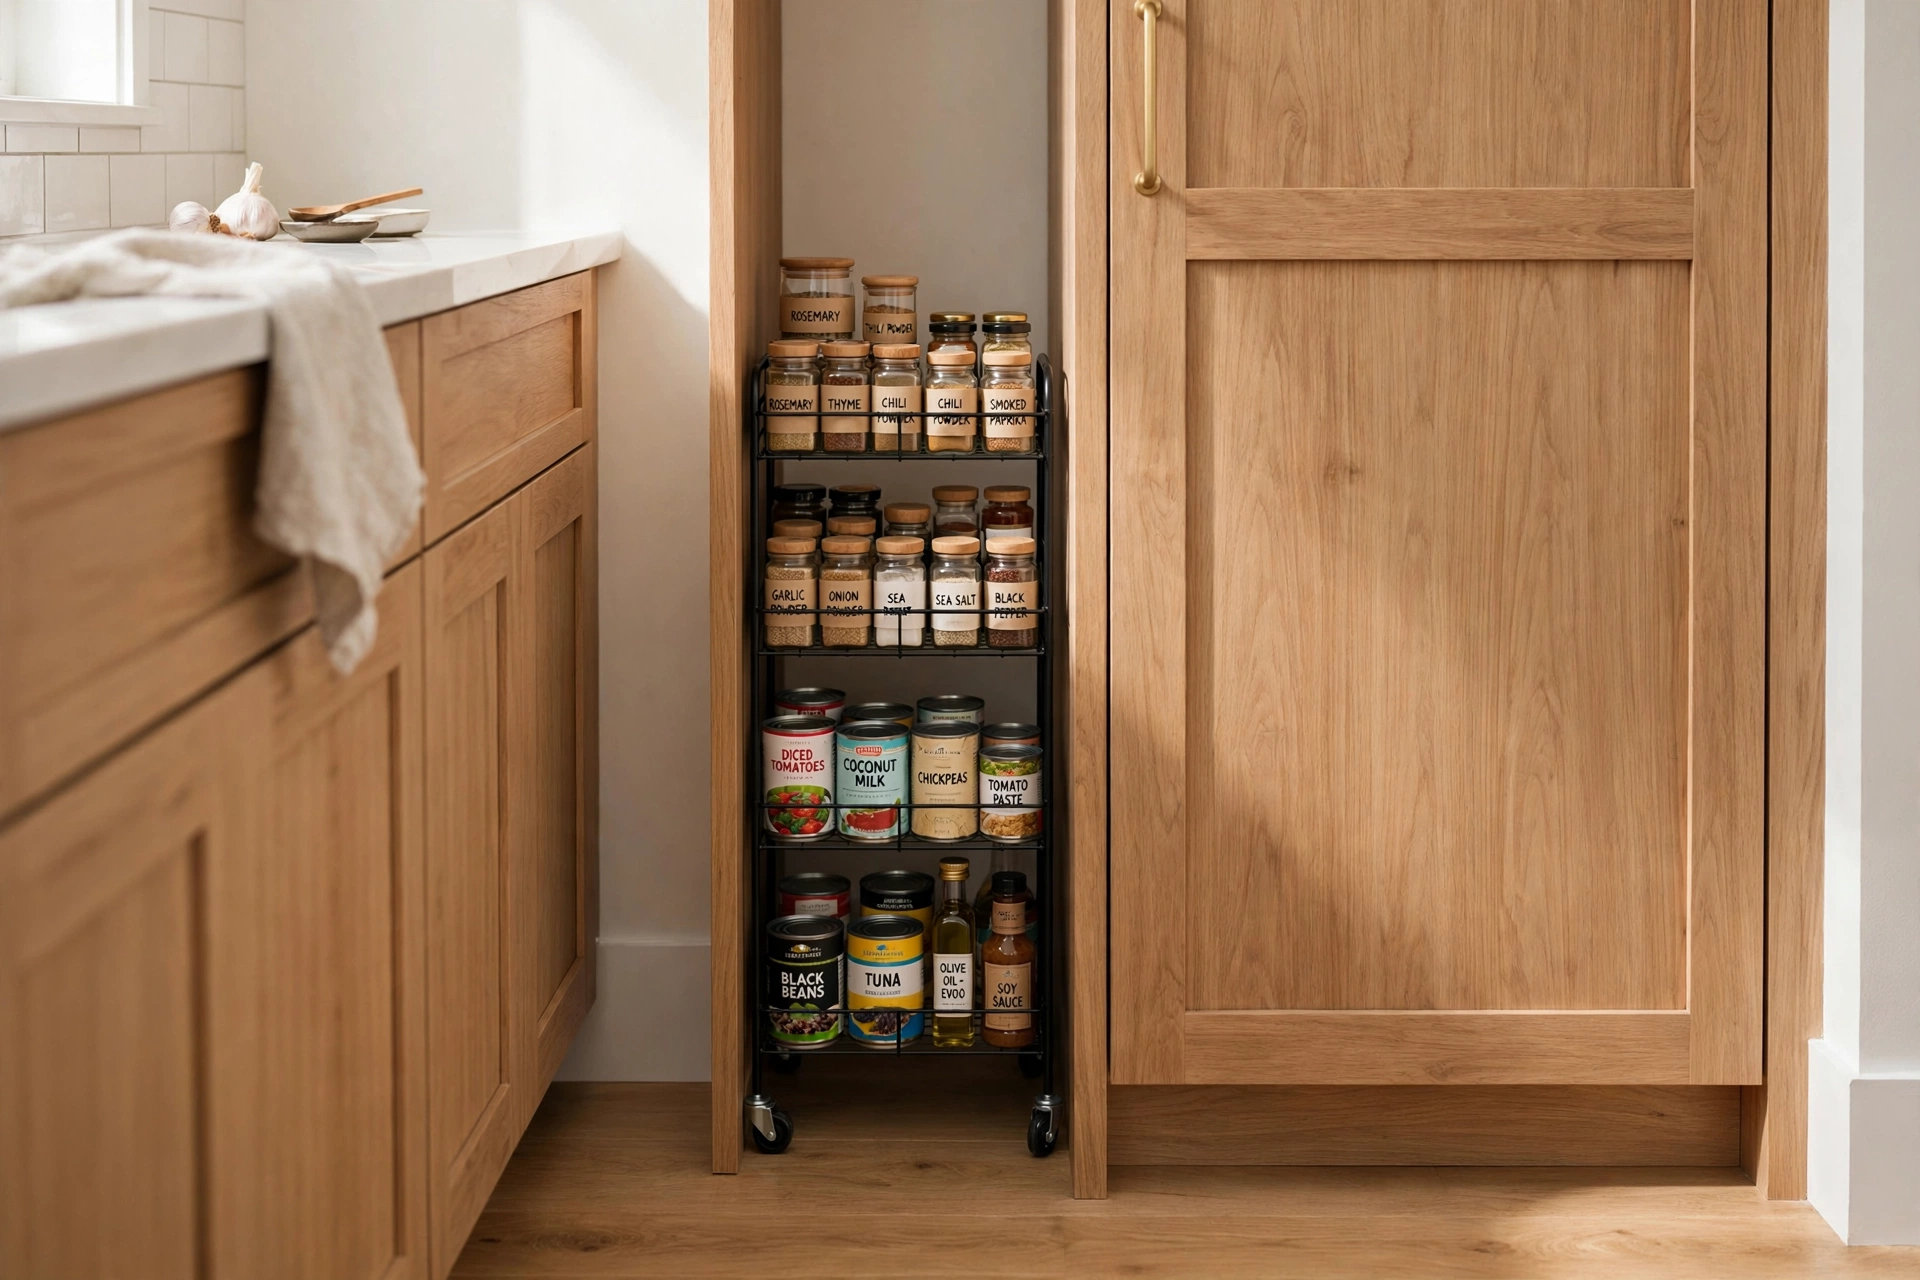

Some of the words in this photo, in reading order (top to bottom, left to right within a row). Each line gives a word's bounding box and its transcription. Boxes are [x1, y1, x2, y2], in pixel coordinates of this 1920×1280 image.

[790, 310, 841, 322] ROSEMARY
[769, 398, 814, 411] ROSEMARY
[827, 398, 862, 411] THYME
[881, 397, 907, 409] CHILI
[937, 398, 963, 409] CHILI
[990, 398, 1027, 411] SMOKED
[771, 589, 805, 601] GARLIC
[828, 590, 859, 602] ONION
[887, 592, 906, 604] SEA
[935, 594, 953, 606] SEA
[955, 593, 976, 606] SALT
[995, 592, 1026, 604] BLACK
[781, 749, 813, 761] DICED
[771, 759, 825, 773] TOMATOES
[843, 758, 898, 774] COCONUT
[855, 774, 886, 788] MILK
[917, 771, 968, 786] CHICKPEAS
[988, 779, 1029, 792] TOMATO
[993, 793, 1024, 806] PASTE
[940, 963, 967, 974] OLIVE
[781, 971, 825, 986] BLACK
[865, 972, 902, 988] TUNA
[943, 975, 958, 986] OIL
[782, 985, 825, 1000] BEANS
[941, 988, 966, 999] EVOO
[997, 982, 1018, 995] SOY
[992, 995, 1024, 1009] SAUCE
